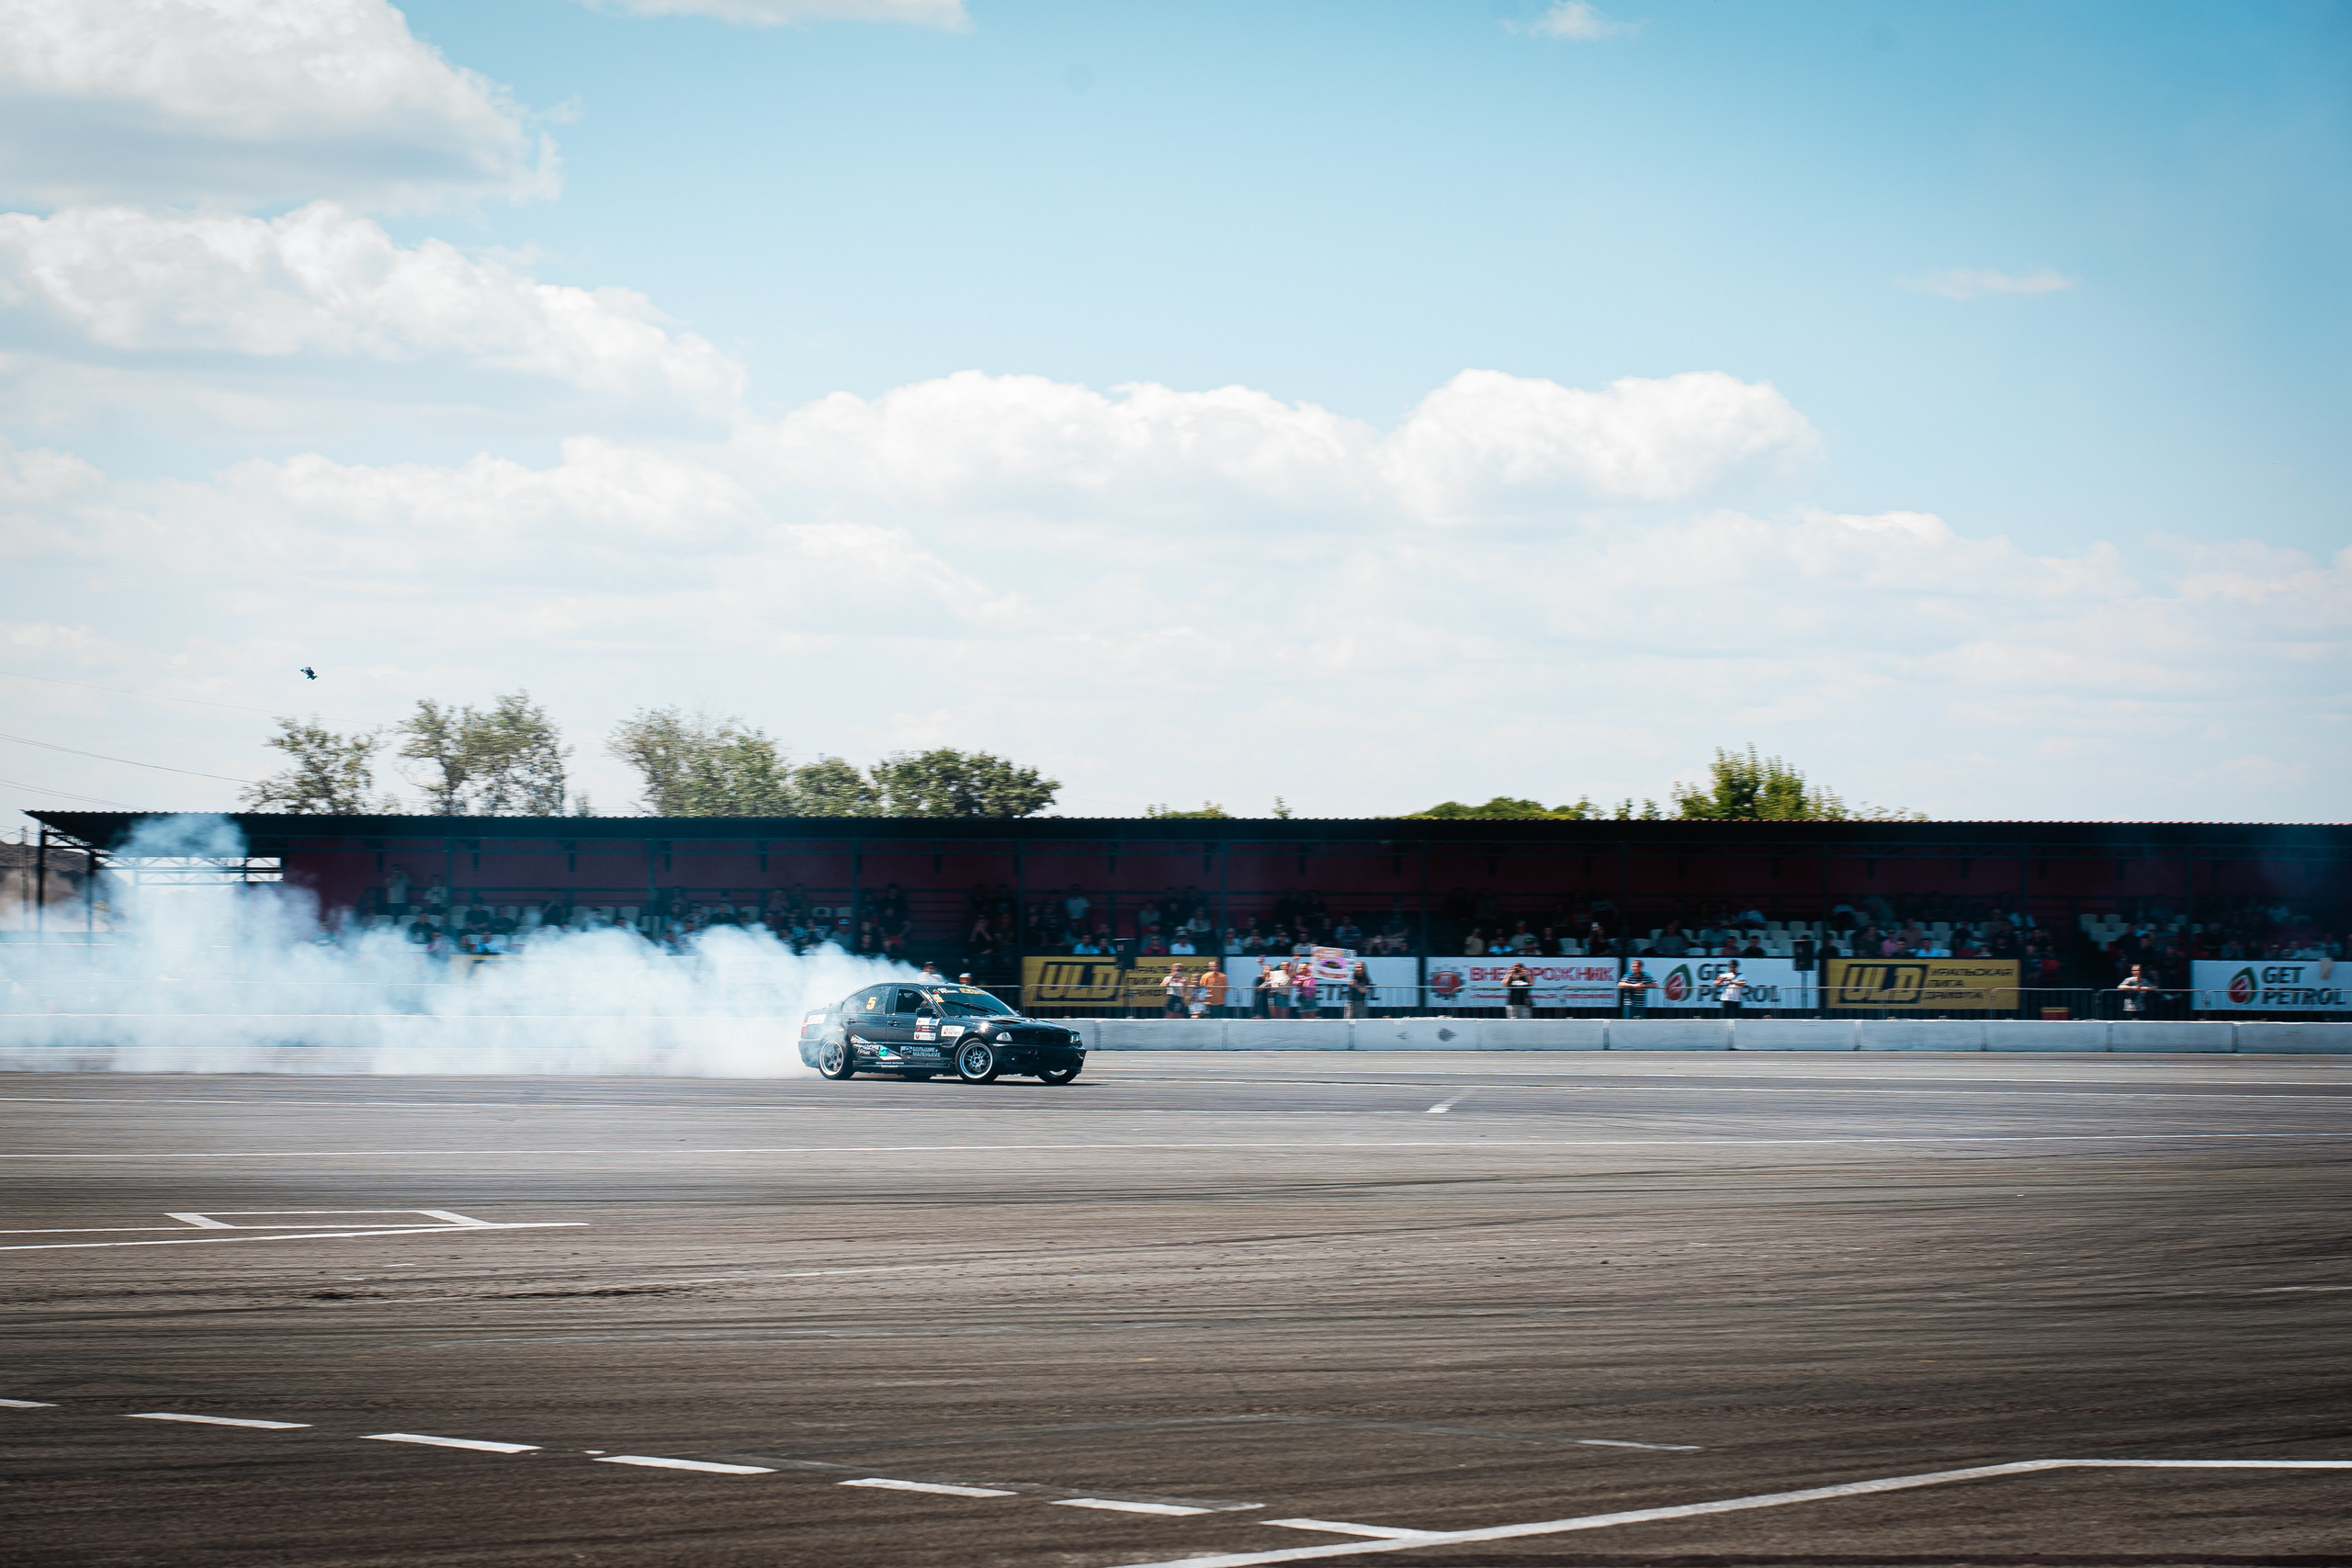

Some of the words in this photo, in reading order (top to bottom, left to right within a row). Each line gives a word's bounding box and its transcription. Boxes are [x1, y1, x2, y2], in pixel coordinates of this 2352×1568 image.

[1470, 966, 1616, 981] ВНЕРОЖНИК
[1697, 963, 1731, 981] GE
[1929, 967, 2014, 976] УРАЛЬСКАЯ
[2260, 966, 2306, 984] GET
[1039, 964, 1121, 998] ULD
[1841, 966, 1925, 1001] ULD
[1926, 979, 1965, 987] ЛИГА
[1696, 984, 1782, 1002] PEROL
[2260, 987, 2346, 1005] PETROL
[865, 996, 877, 1010] 5
